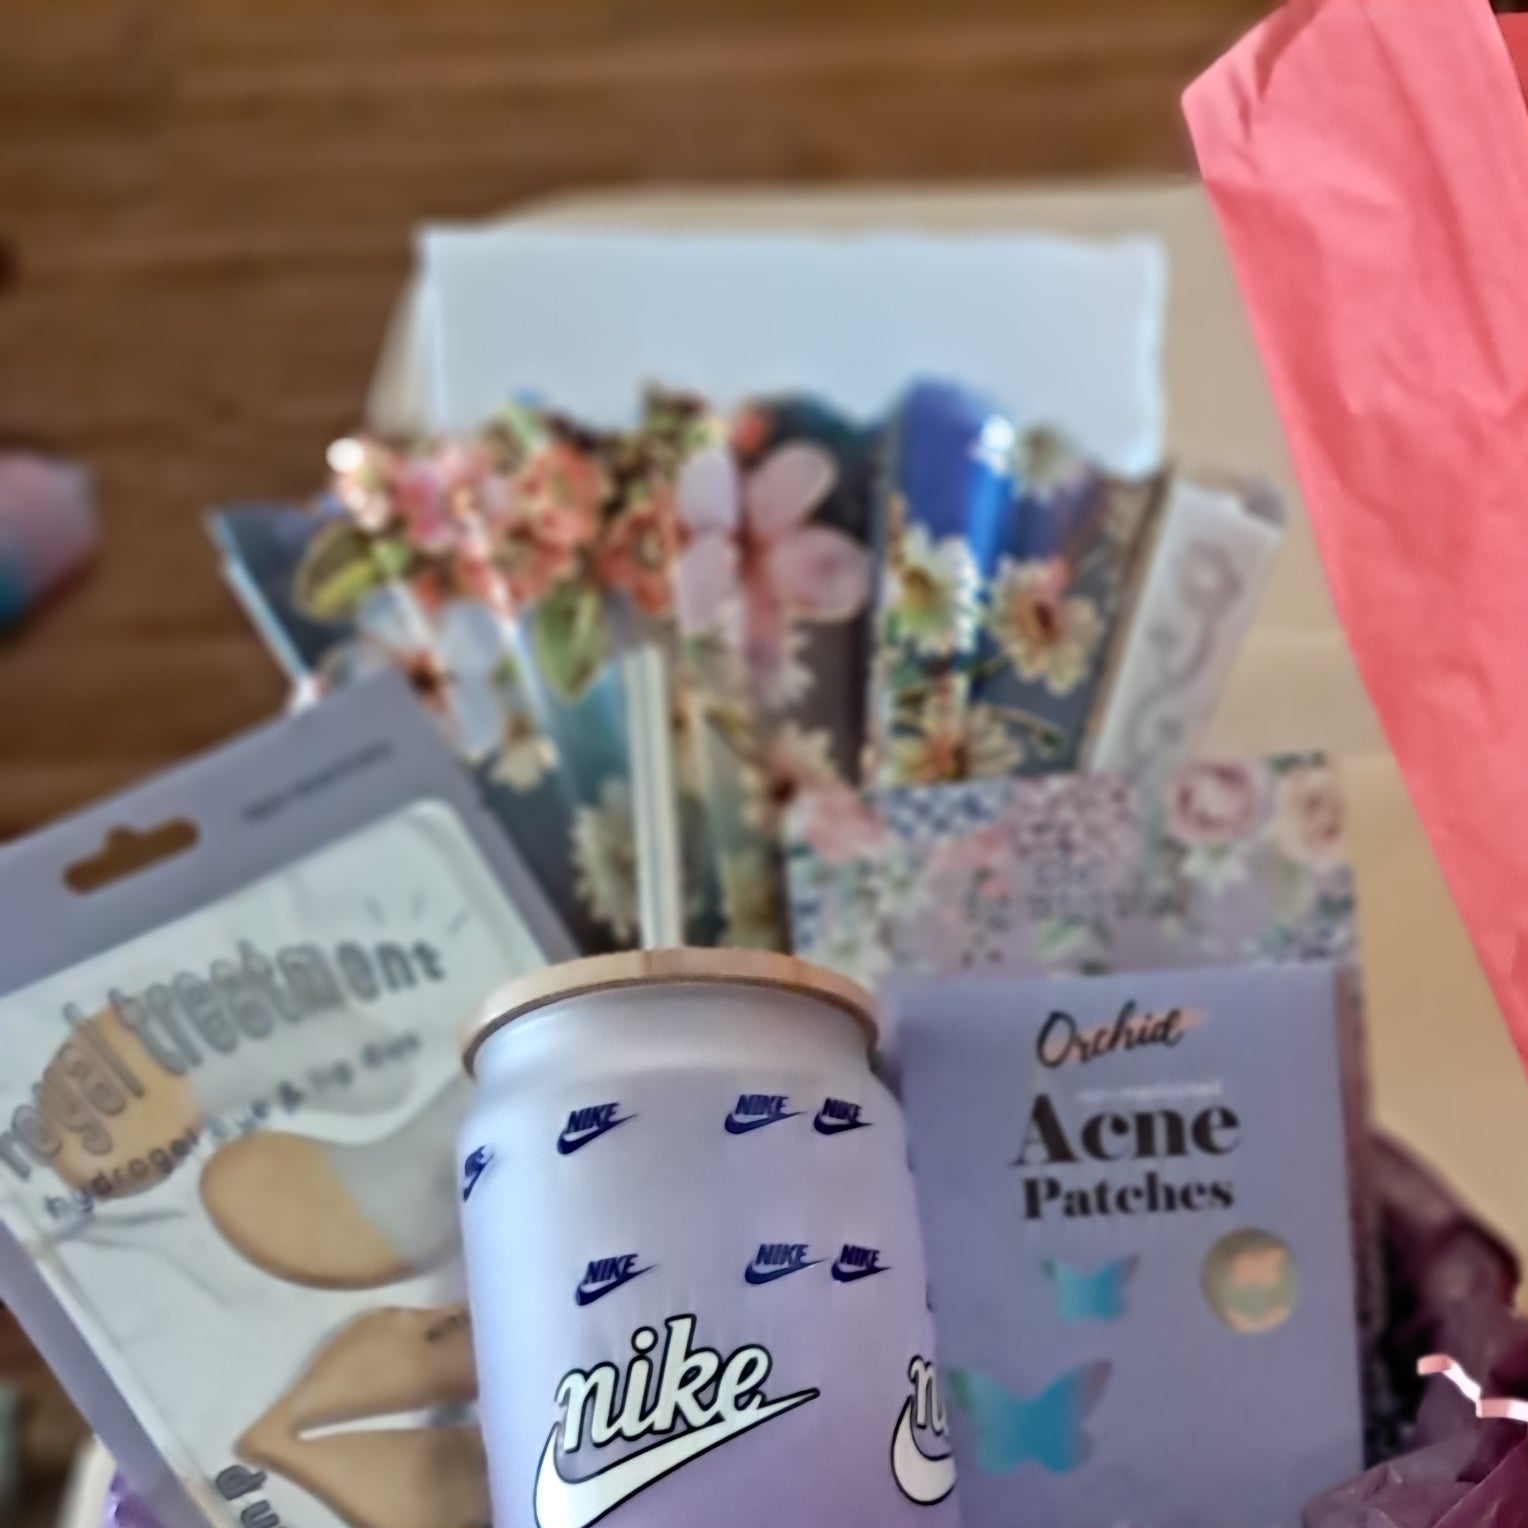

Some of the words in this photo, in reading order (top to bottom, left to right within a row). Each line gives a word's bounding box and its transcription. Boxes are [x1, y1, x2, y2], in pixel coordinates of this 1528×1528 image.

[1036, 999, 1184, 1069] Orchid
[567, 1102, 620, 1131] NIKE
[736, 1094, 790, 1117] NIKE
[822, 1097, 863, 1121] NIKE
[1008, 1093, 1241, 1167] Acne
[1023, 1171, 1235, 1220] Patches
[585, 1253, 640, 1284] NIKE
[755, 1243, 810, 1266] NIKE
[840, 1243, 881, 1268] NIKE
[555, 1313, 773, 1454] nike
